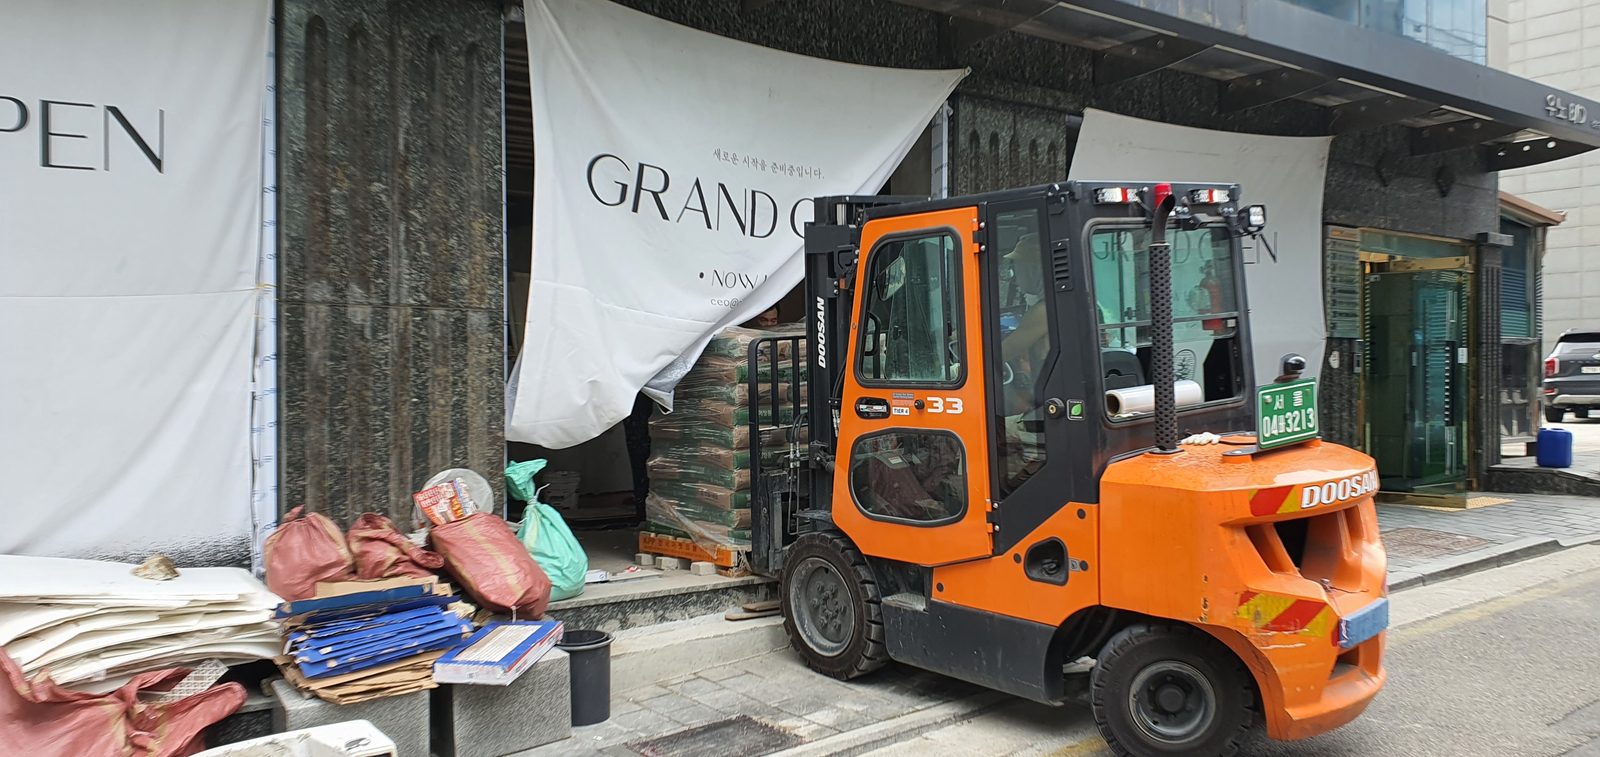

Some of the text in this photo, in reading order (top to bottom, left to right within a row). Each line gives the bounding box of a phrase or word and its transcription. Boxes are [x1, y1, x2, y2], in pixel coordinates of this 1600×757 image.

[713, 148, 825, 180] 새로운 시작을 준비중입니다.
[586, 153, 778, 238] GRAND
[711, 269, 759, 289] NOW
[710, 297, 744, 310] ceo@
[817, 296, 826, 369] DOOSAN
[926, 396, 963, 414] 33
[1273, 390, 1303, 410] 서울
[1301, 469, 1377, 509] DOOSAN
